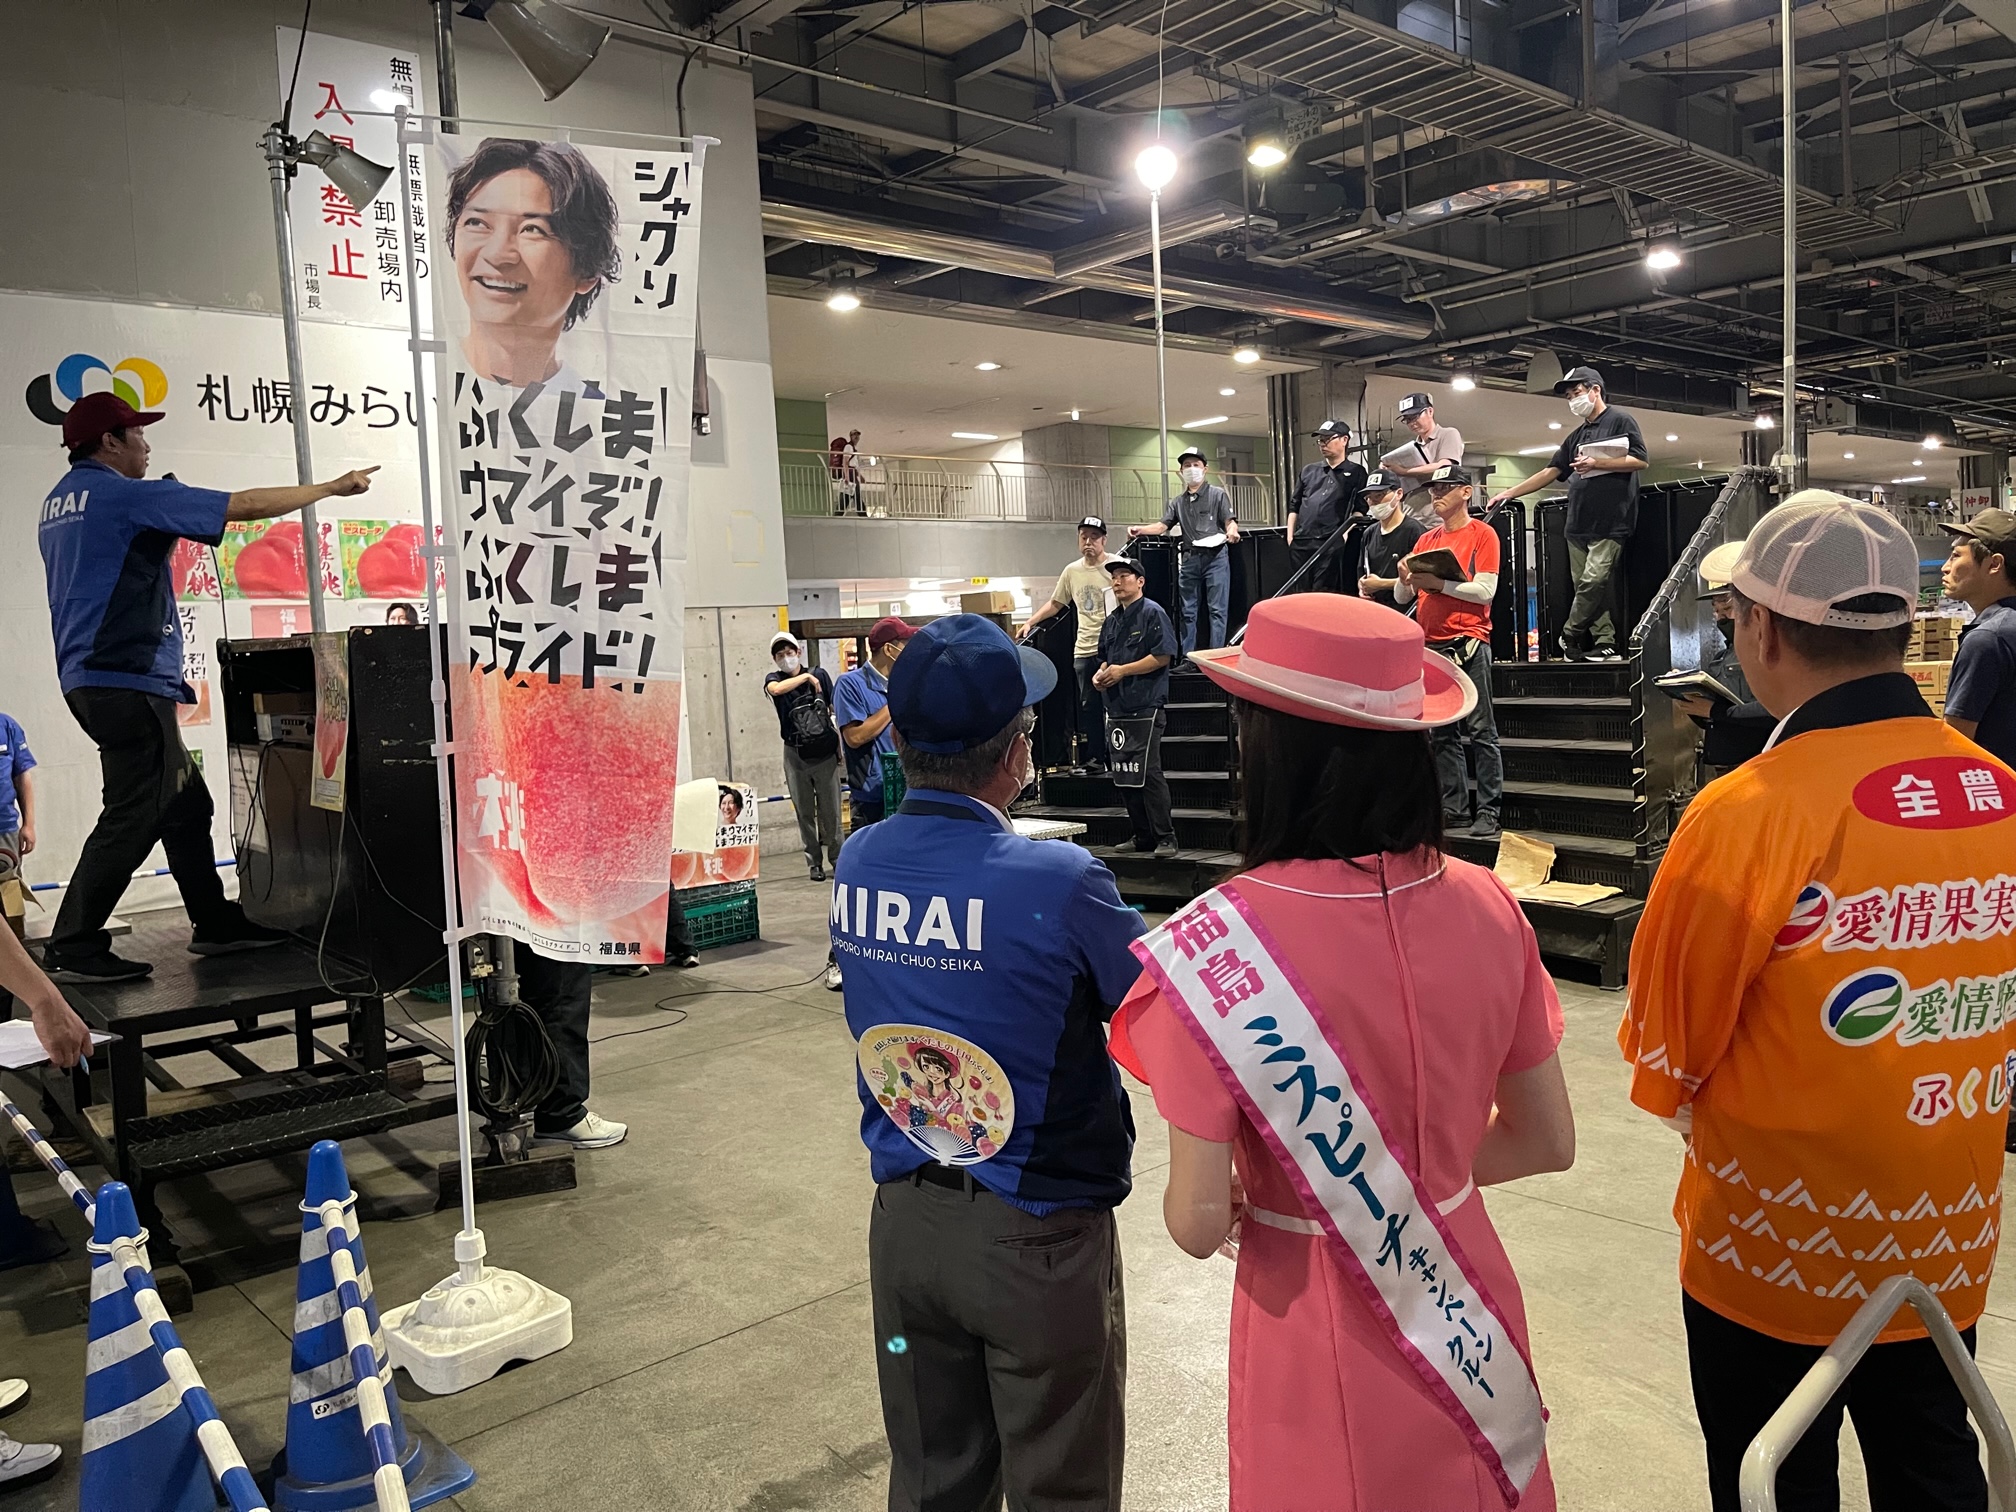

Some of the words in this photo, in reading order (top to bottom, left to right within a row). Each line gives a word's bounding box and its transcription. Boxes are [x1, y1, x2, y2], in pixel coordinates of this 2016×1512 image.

[314, 81, 368, 280] 入禁止
[374, 199, 402, 302] 卸売場内
[635, 161, 691, 309] シャクリ
[304, 263, 321, 309] 市場長
[40, 490, 90, 523] IRAI
[1964, 495, 1990, 508] 仲卸
[1891, 768, 2005, 819] 全農
[830, 882, 984, 951] MIRAI
[1831, 880, 2016, 947] 愛情果実
[599, 942, 642, 956] 福島県
[863, 946, 898, 963] MIRAI
[900, 953, 936, 969] CHUO
[940, 958, 984, 972] SEIKA
